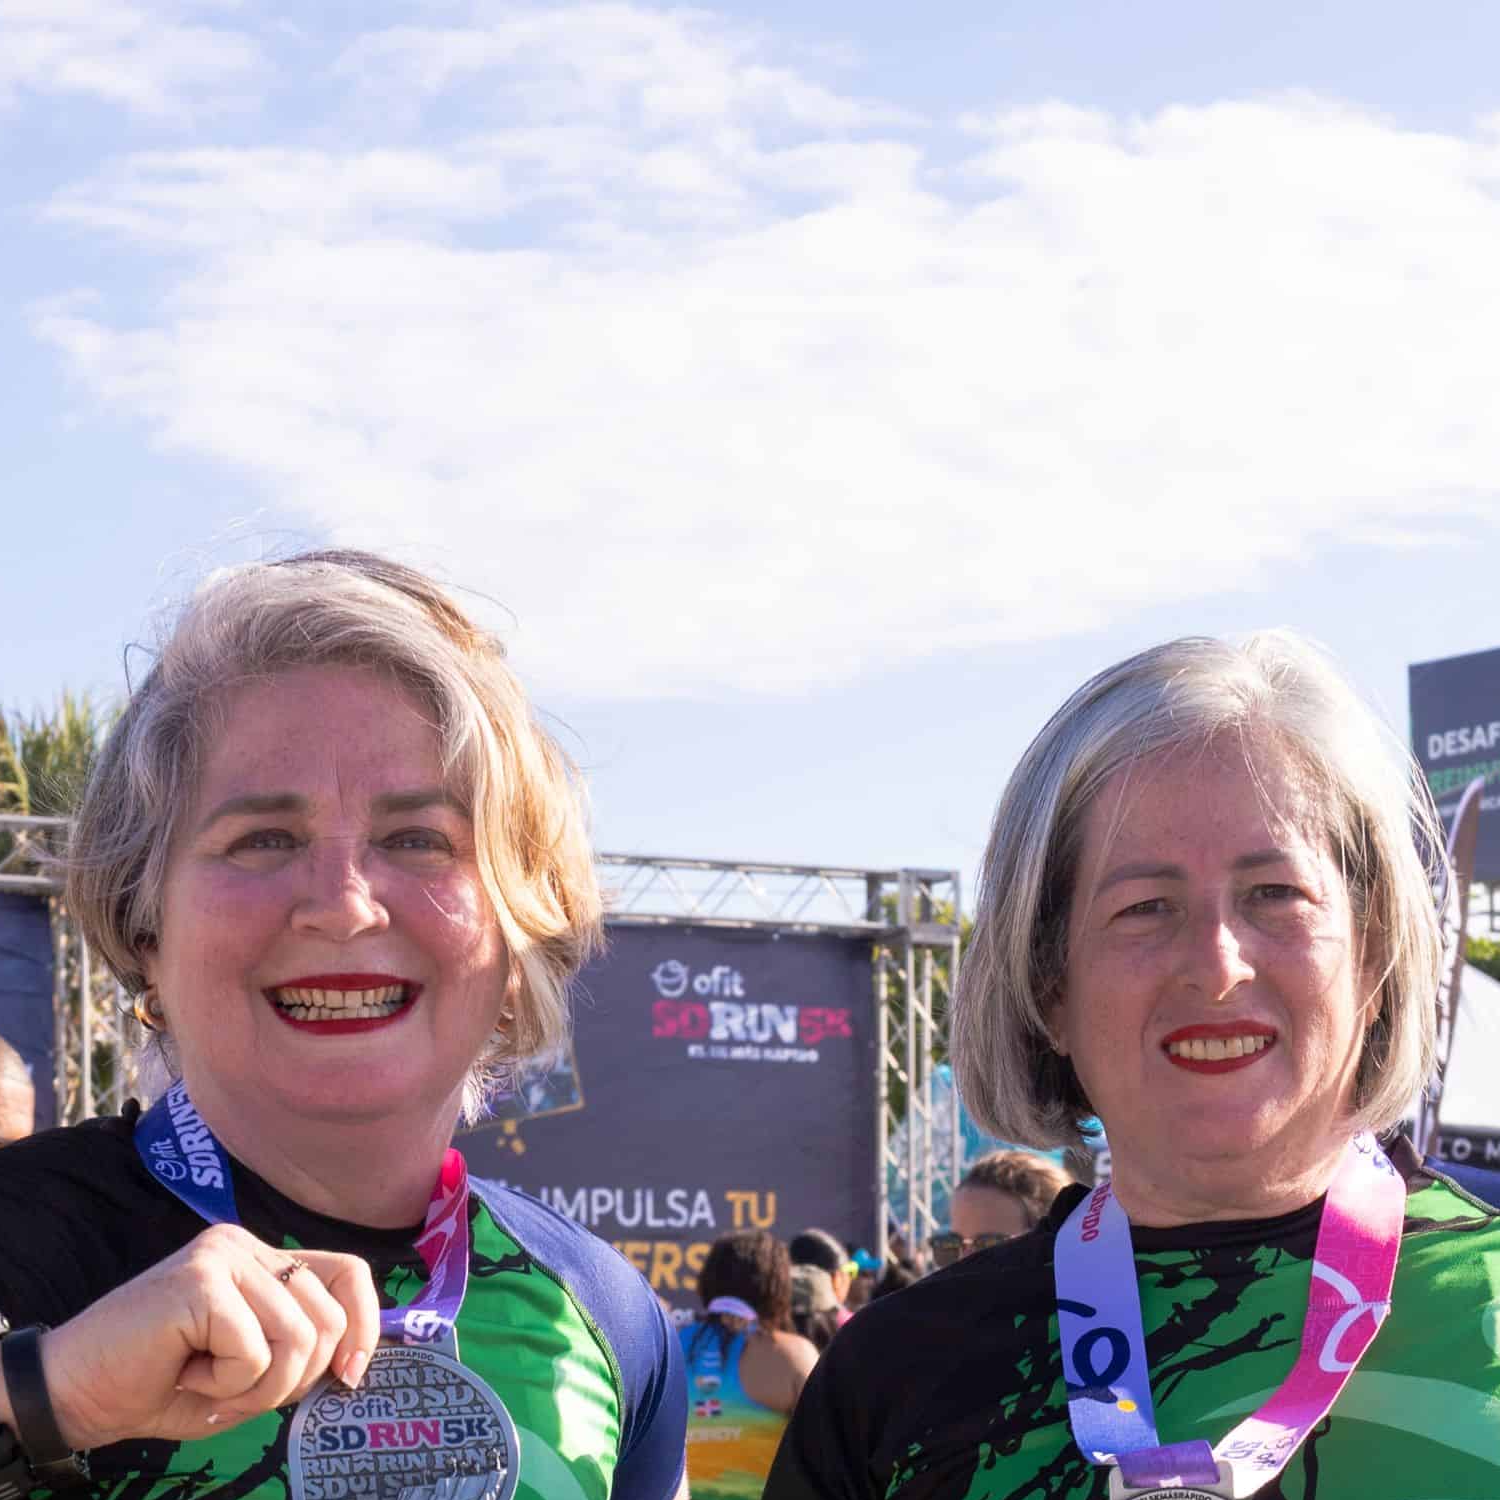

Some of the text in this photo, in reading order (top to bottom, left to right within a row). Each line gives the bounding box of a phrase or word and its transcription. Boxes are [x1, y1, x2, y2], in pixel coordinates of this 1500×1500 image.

[693, 966, 745, 997] ofit
[725, 1190, 778, 1229] TU
[351, 1397, 396, 1419] ofit
[317, 1416, 491, 1452] SDRUN5K
